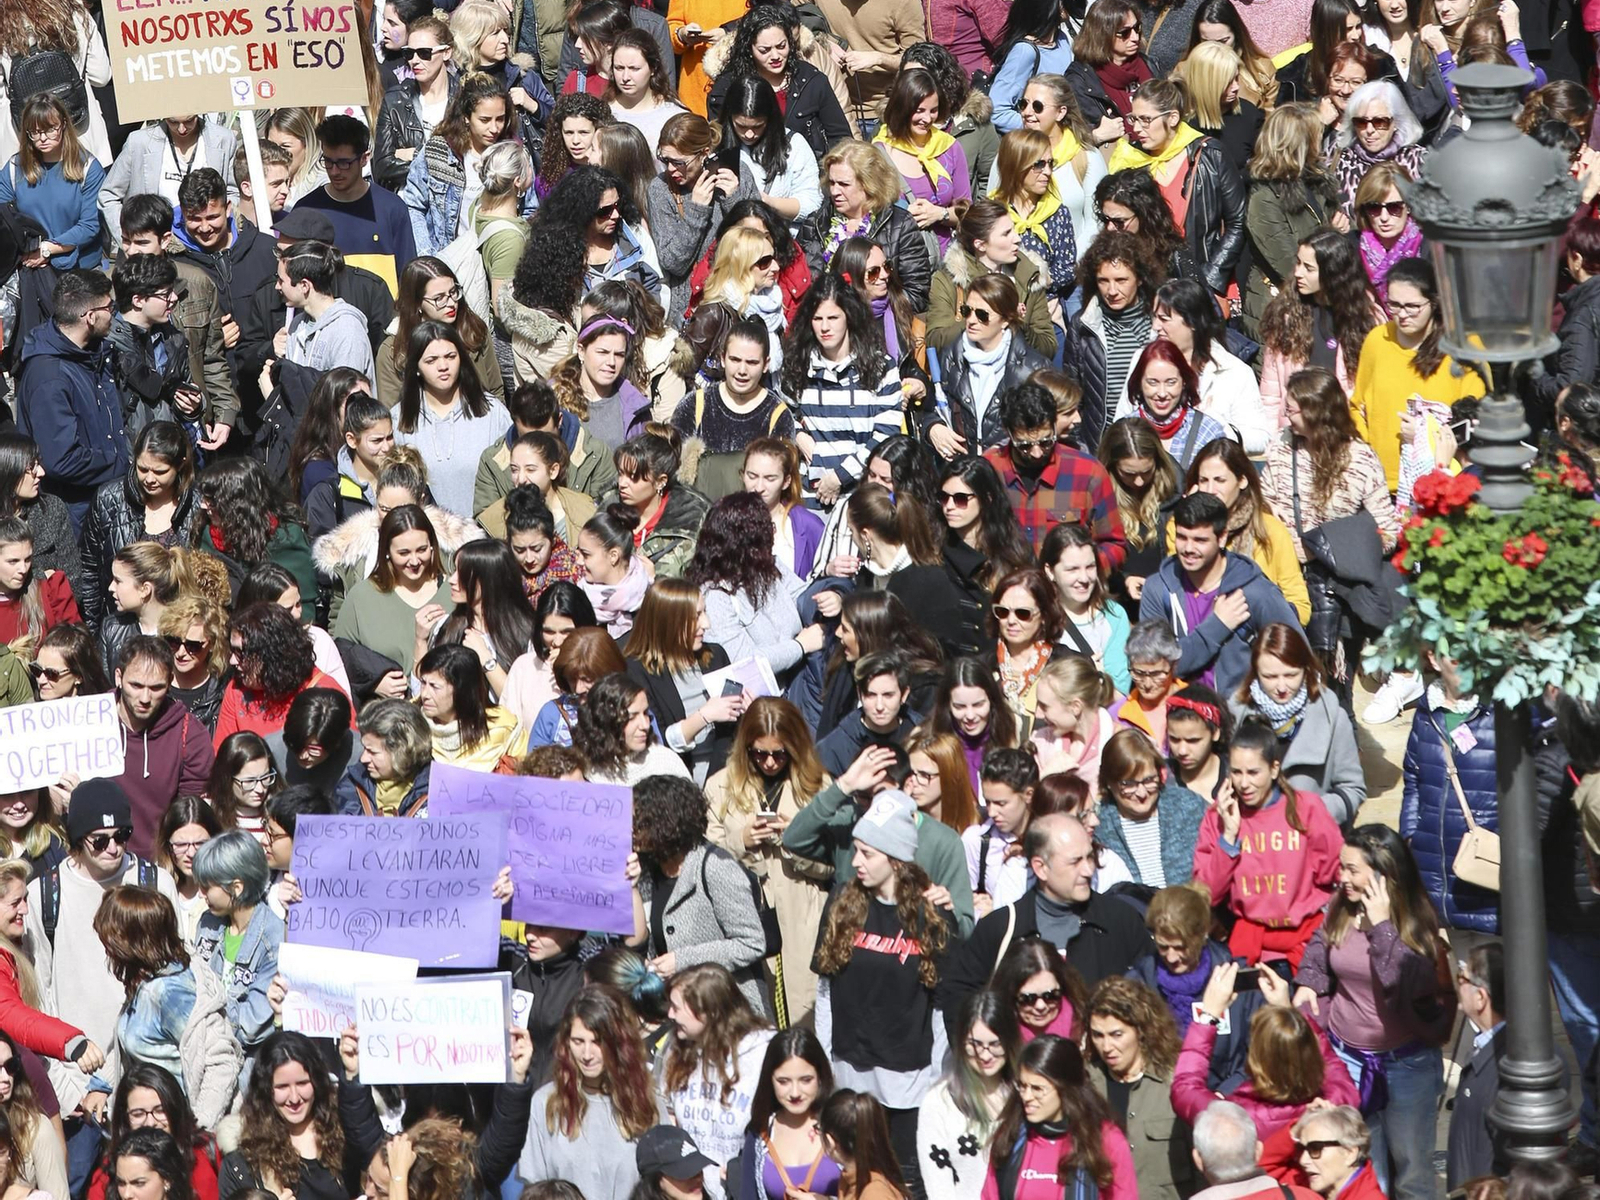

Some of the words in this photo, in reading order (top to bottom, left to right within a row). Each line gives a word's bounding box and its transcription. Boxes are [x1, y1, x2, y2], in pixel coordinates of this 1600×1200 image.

[121, 8, 254, 48] NOSOTRXS
[265, 0, 299, 34] SÍ
[302, 5, 354, 34] NOS
[125, 45, 242, 85] METEMOS
[246, 42, 279, 72] EN
[0, 698, 114, 736] TRONGER
[0, 737, 122, 788] OGETHER
[437, 780, 453, 803] A
[466, 784, 496, 805] LA
[513, 789, 624, 817] SOCIEDAD
[297, 820, 404, 842] NUESTROS
[507, 810, 574, 845] DIGNA
[1242, 830, 1300, 854] AUGH
[294, 845, 322, 870] SE
[561, 856, 615, 875] LIBRE
[385, 877, 481, 900] ESTEMOS
[1241, 873, 1287, 897] LIVE
[288, 906, 341, 932] BAJO
[380, 907, 467, 930] TIERRA.
[361, 996, 388, 1022] NO
[391, 996, 413, 1023] ES
[367, 1033, 390, 1059] ES
[396, 1032, 444, 1073] POR
[680, 1081, 750, 1113] PEARON
